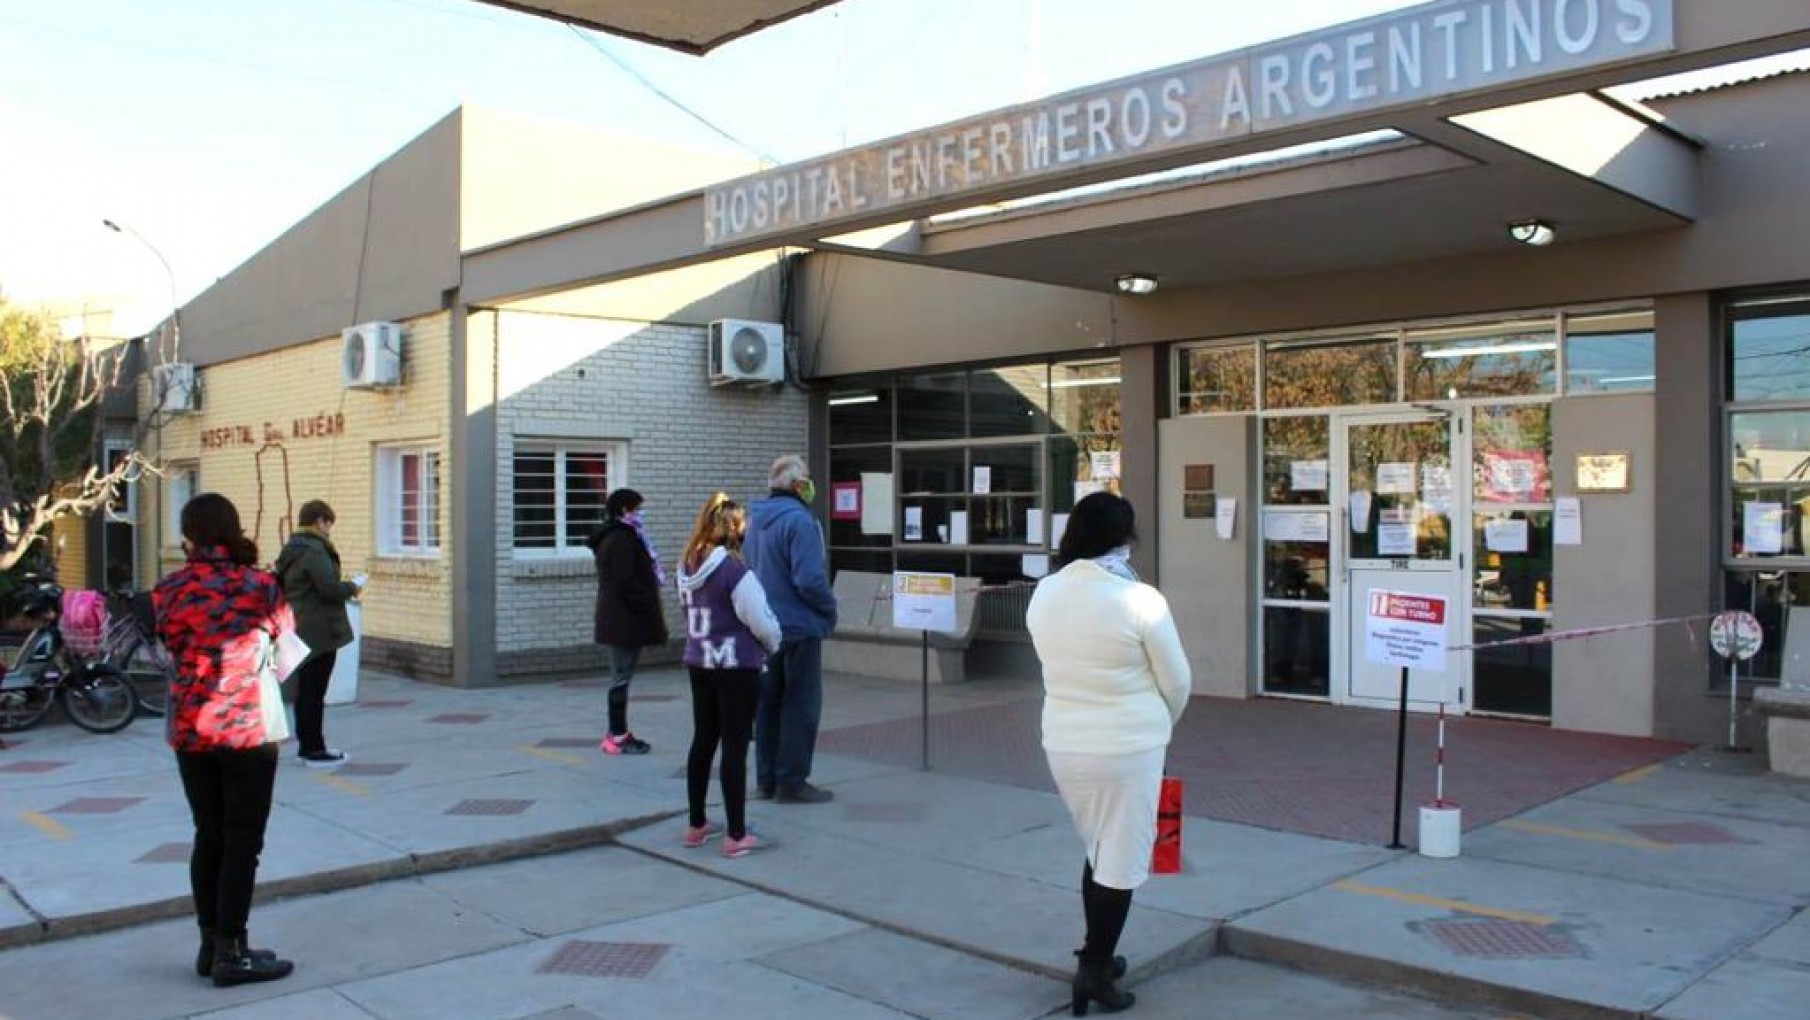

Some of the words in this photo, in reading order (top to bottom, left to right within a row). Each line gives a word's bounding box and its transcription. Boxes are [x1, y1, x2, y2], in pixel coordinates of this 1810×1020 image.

[710, 167, 869, 235] HOSPITAL
[887, 78, 1188, 201] ENFERMEROS
[1220, 0, 1653, 129] ARGENTINOS
